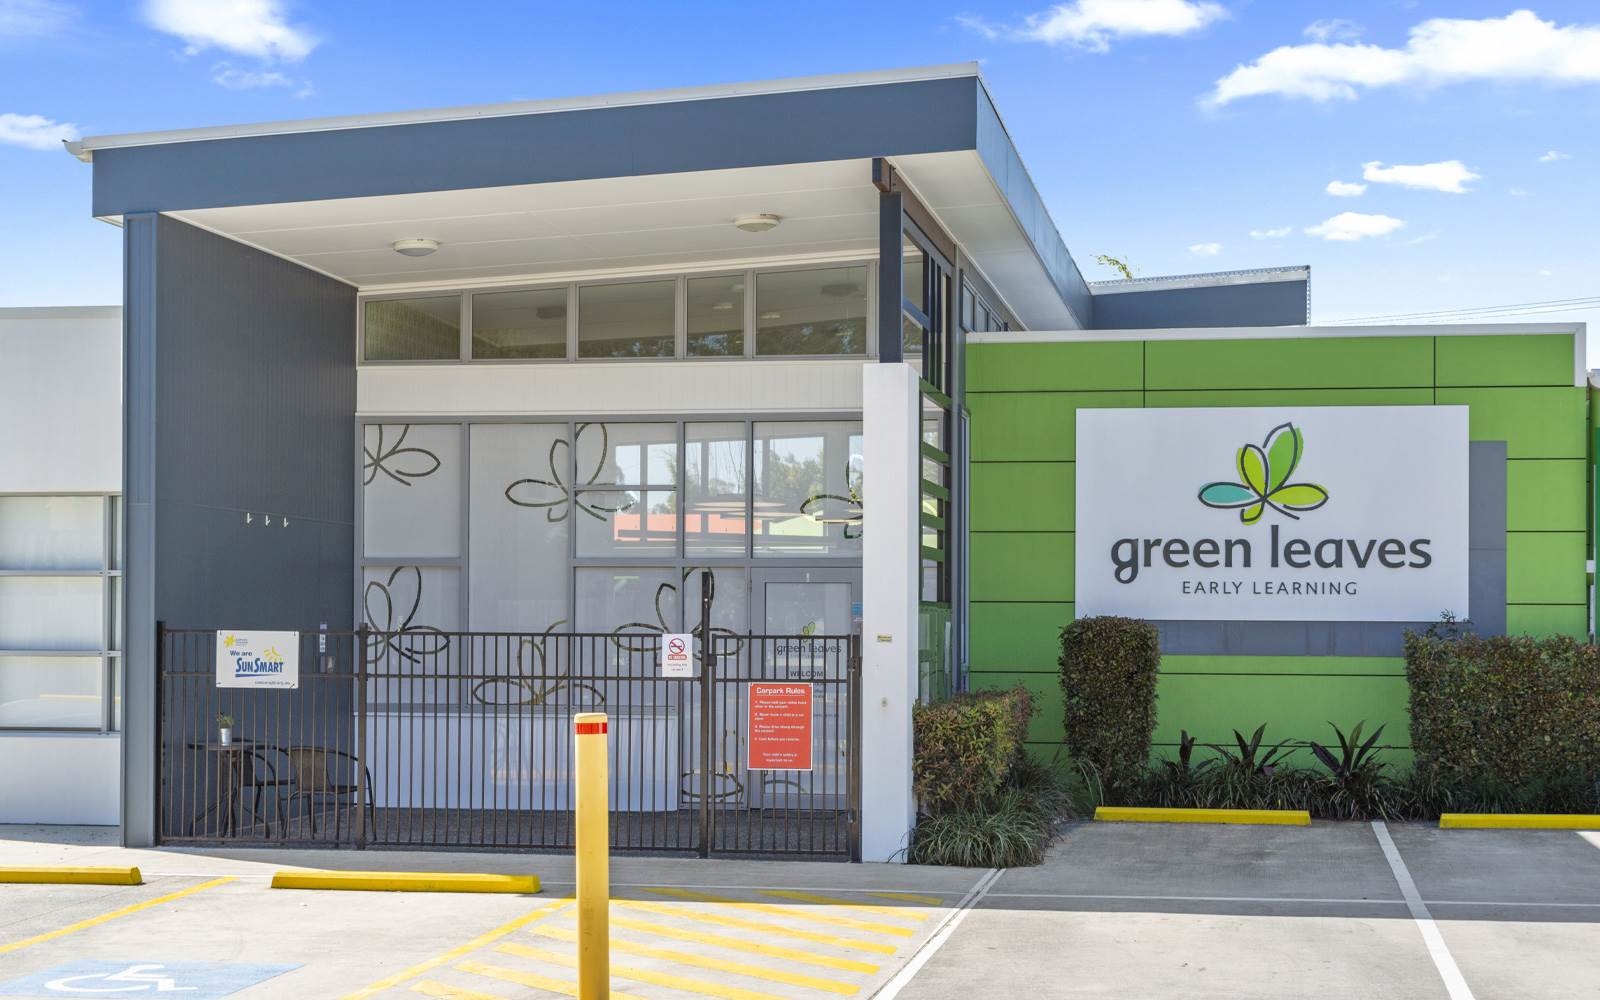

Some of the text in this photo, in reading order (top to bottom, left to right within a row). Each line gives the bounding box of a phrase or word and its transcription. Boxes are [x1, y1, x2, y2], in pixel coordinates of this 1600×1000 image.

[1110, 524, 1433, 584] green leaves
[1182, 581, 1358, 596] EARLY LEARNING
[777, 645, 806, 656] green
[790, 670, 826, 678] WELCOM
[756, 687, 784, 695] Carpark
[785, 687, 806, 695] Rules
